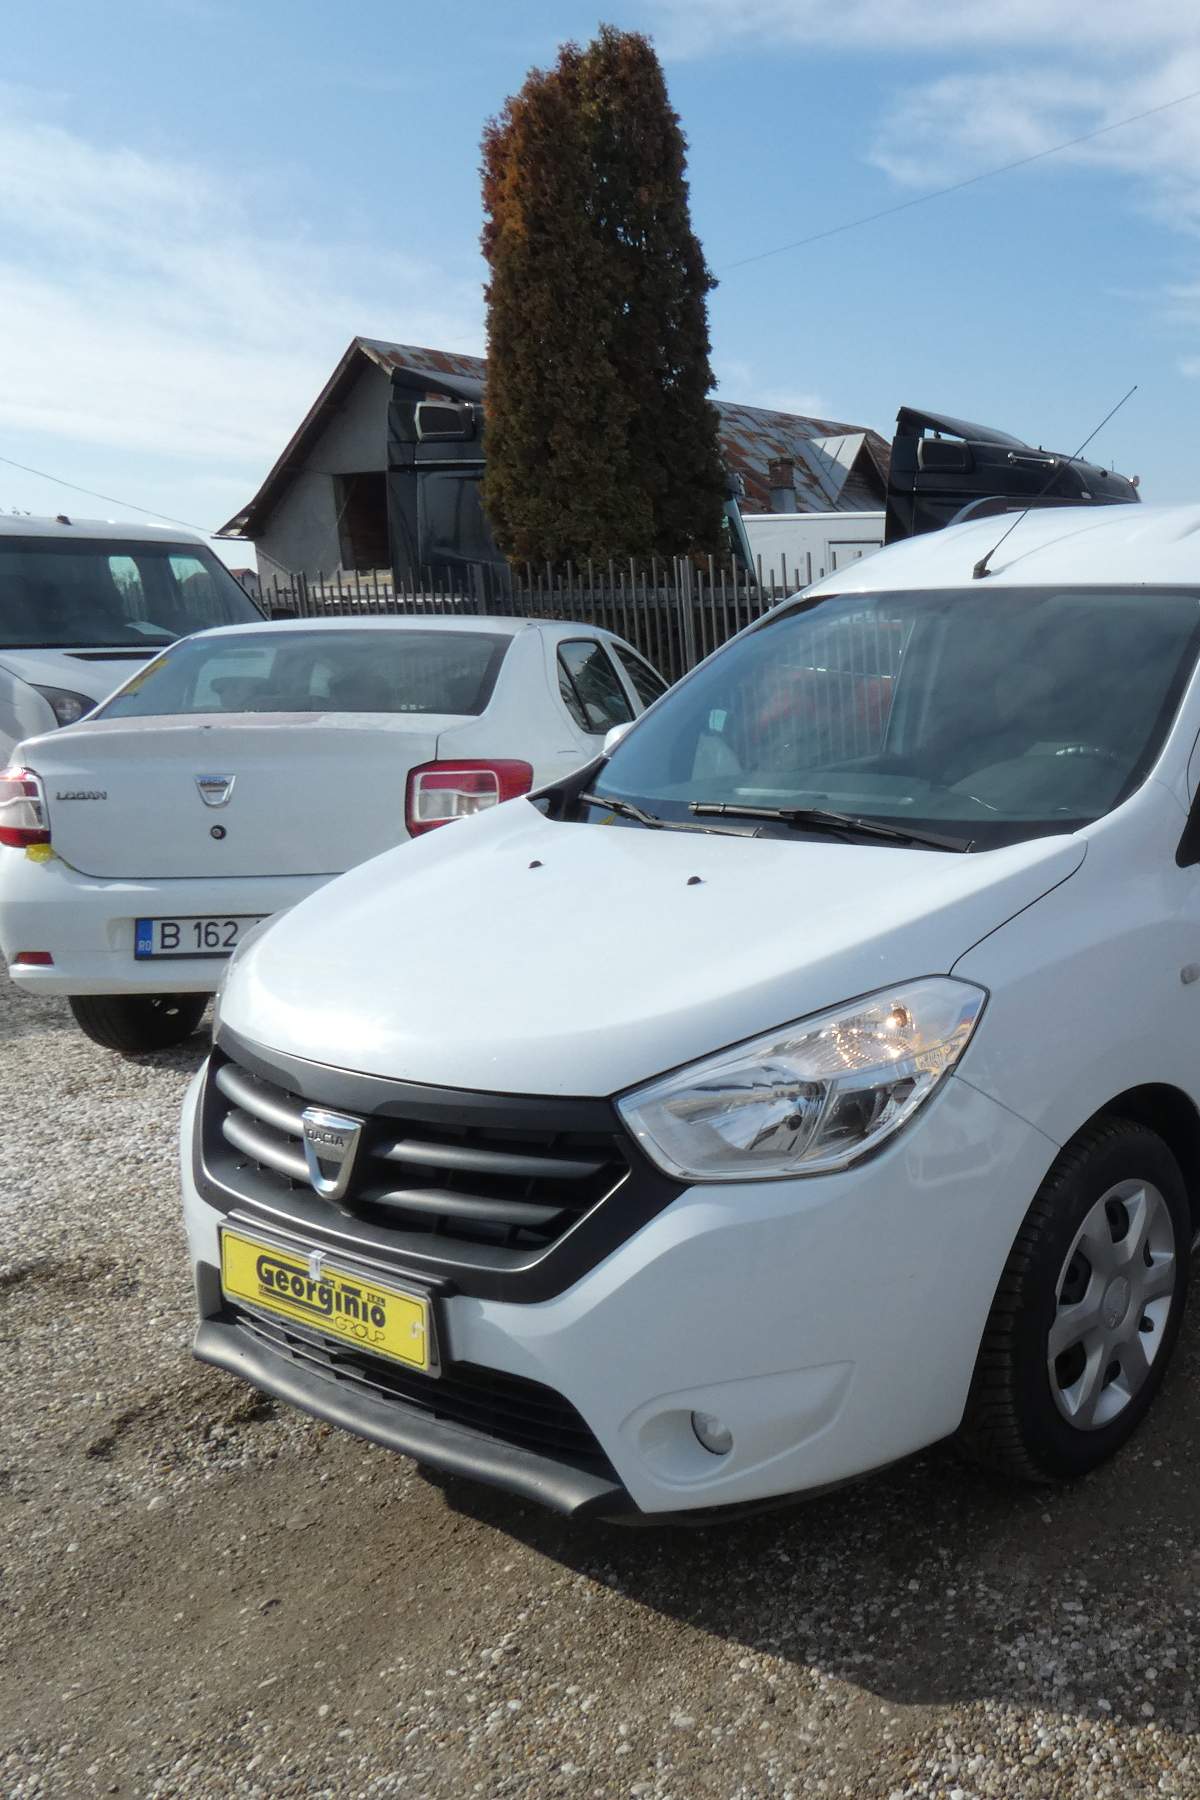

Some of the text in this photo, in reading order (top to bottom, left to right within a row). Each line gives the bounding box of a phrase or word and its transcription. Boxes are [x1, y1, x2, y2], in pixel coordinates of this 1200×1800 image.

[160, 921, 239, 949] B 162
[256, 1255, 386, 1328] Georginio
